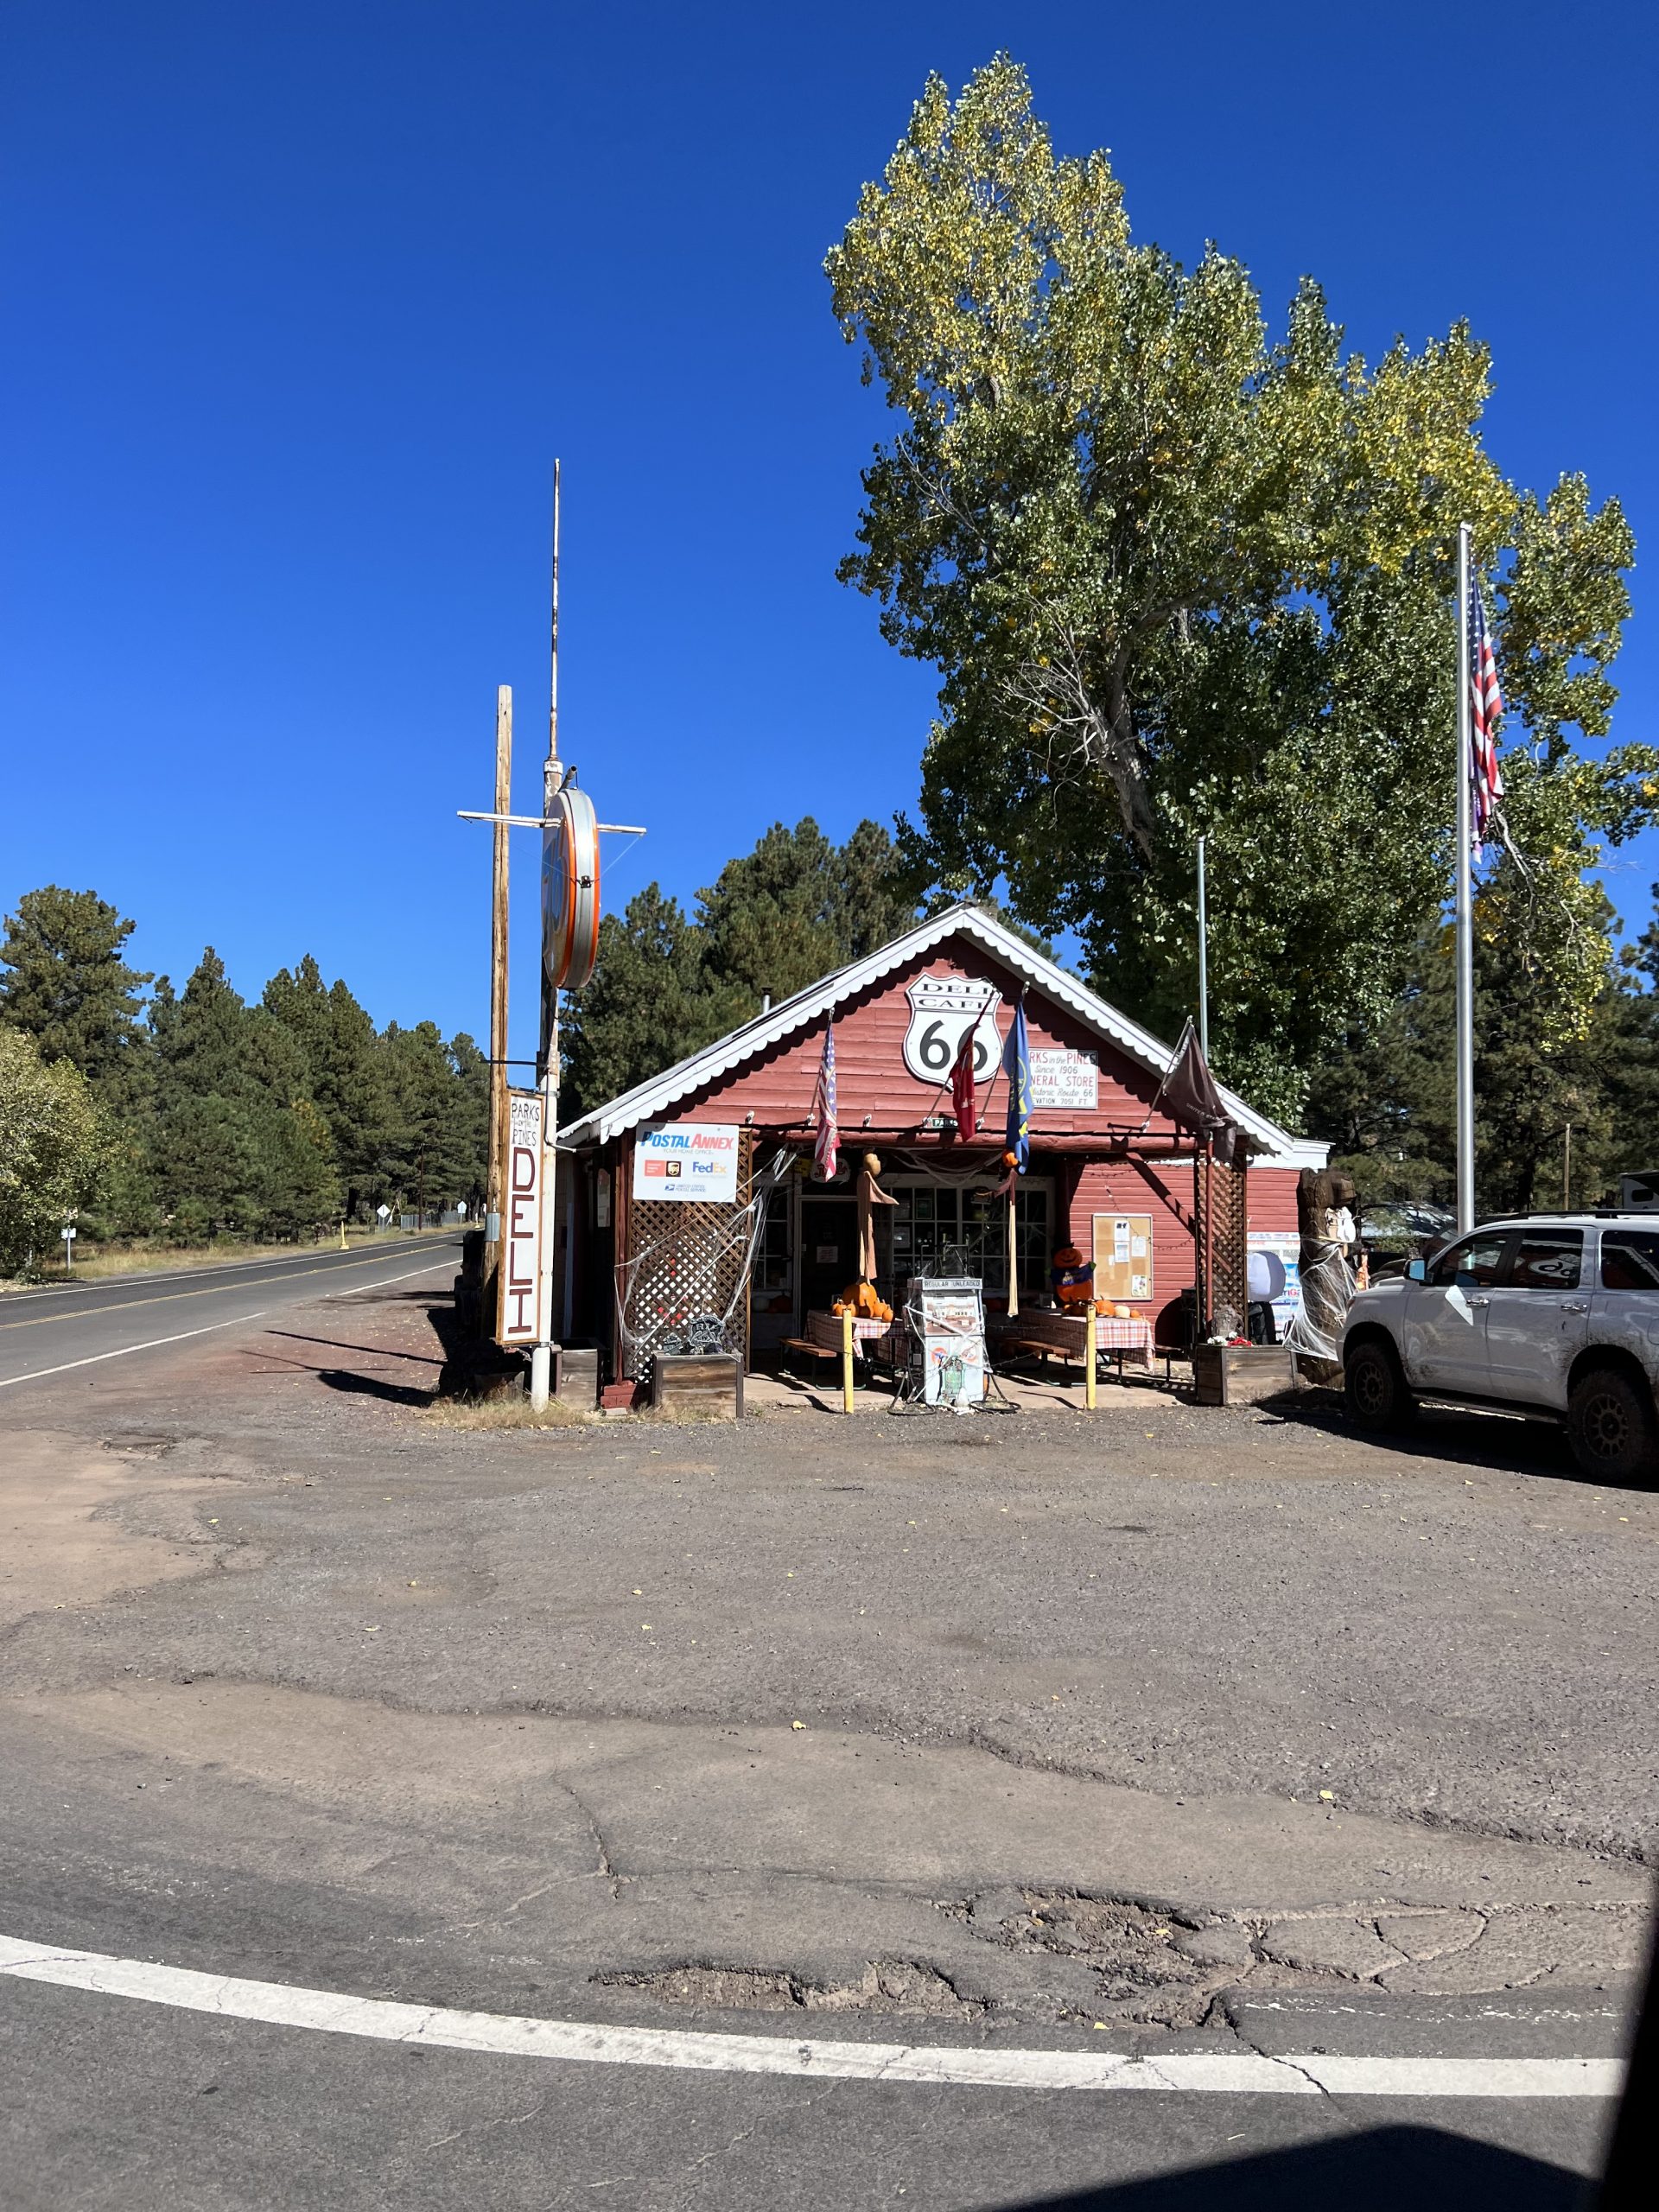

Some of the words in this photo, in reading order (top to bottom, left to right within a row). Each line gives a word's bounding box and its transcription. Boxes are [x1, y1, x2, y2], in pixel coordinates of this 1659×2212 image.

[922, 983, 991, 995] DELI
[919, 1020, 988, 1071] 66
[1029, 1052, 1048, 1063] RKS
[1067, 1052, 1096, 1065] PINES
[1059, 1065, 1078, 1074] 1906
[1031, 1075, 1059, 1086] NERAL
[1066, 1076, 1094, 1087] STORE
[1057, 1088, 1080, 1096] Route
[1084, 1089, 1093, 1097] 66
[512, 1103, 540, 1122] PARKS
[512, 1128, 537, 1147] PINES
[692, 1161, 727, 1174] FedEx
[508, 1147, 536, 1333] DELI
